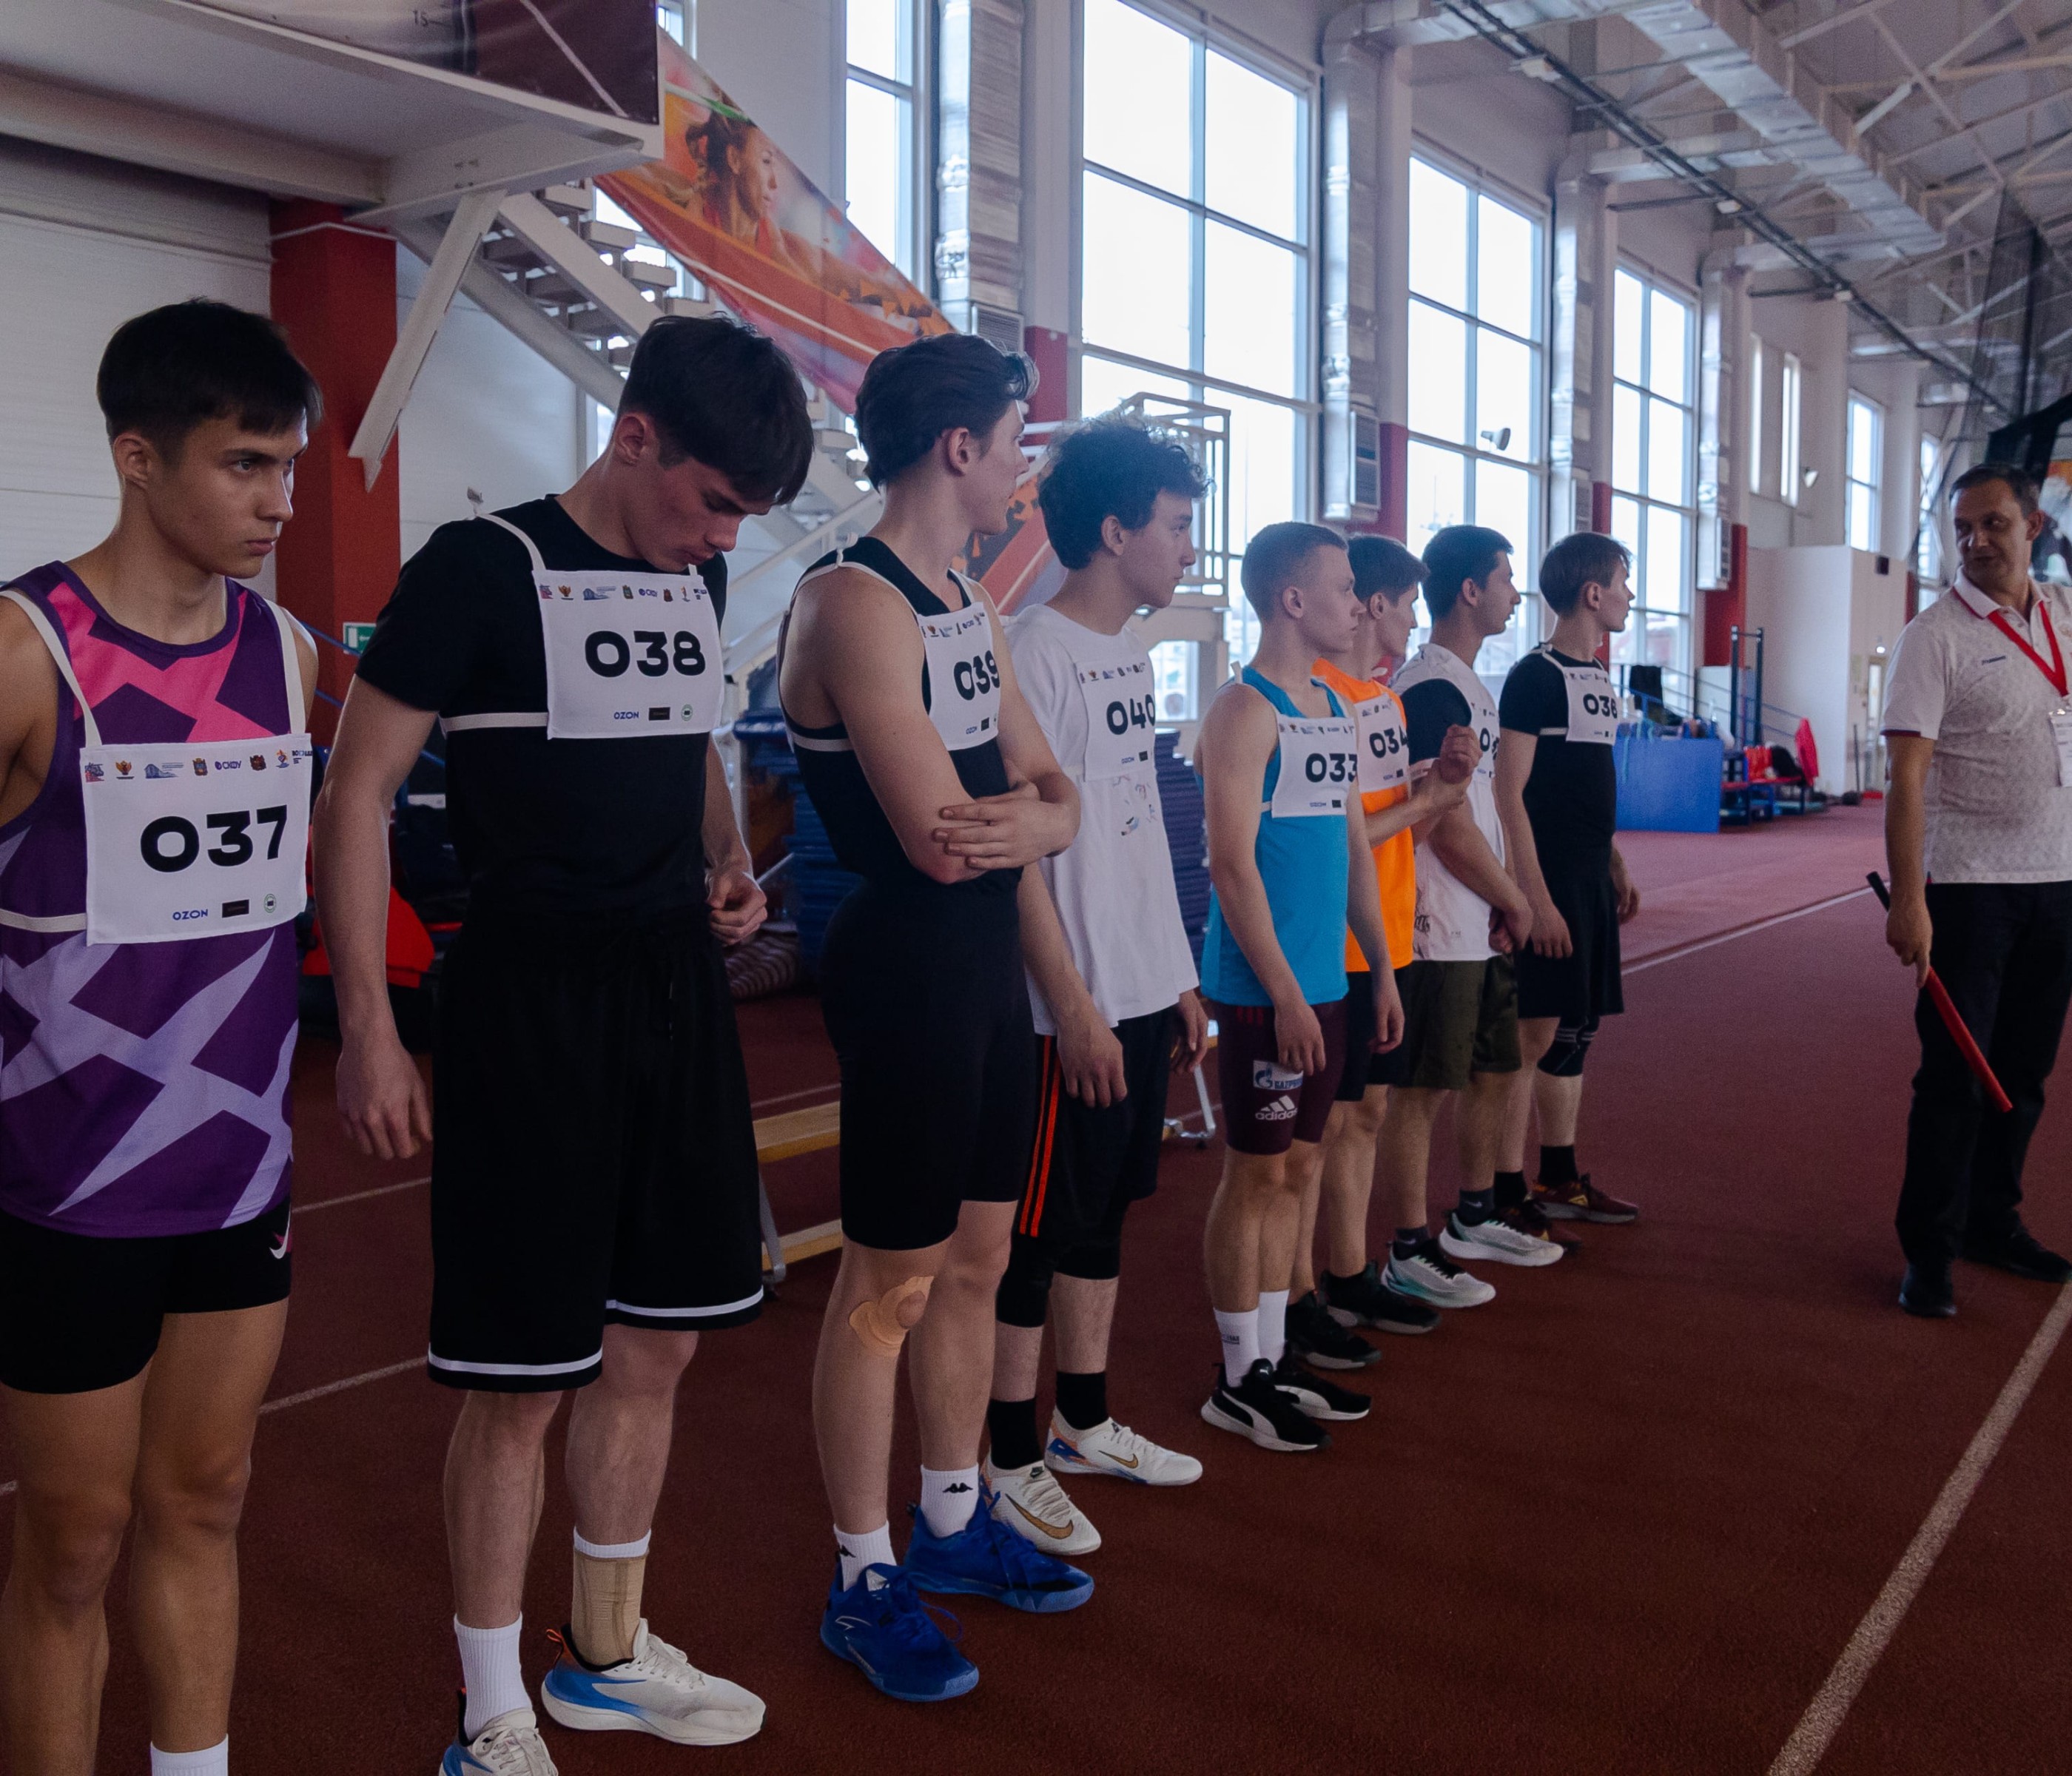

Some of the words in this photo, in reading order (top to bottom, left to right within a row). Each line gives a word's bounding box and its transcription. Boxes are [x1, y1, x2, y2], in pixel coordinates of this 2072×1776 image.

[585, 630, 706, 678] 038
[953, 650, 1000, 701] 039
[613, 710, 639, 720] OZON
[1106, 693, 1155, 735] 040
[1368, 725, 1409, 758] 034
[1305, 753, 1358, 783] 033
[140, 804, 288, 872] 037
[172, 909, 209, 921] OZON
